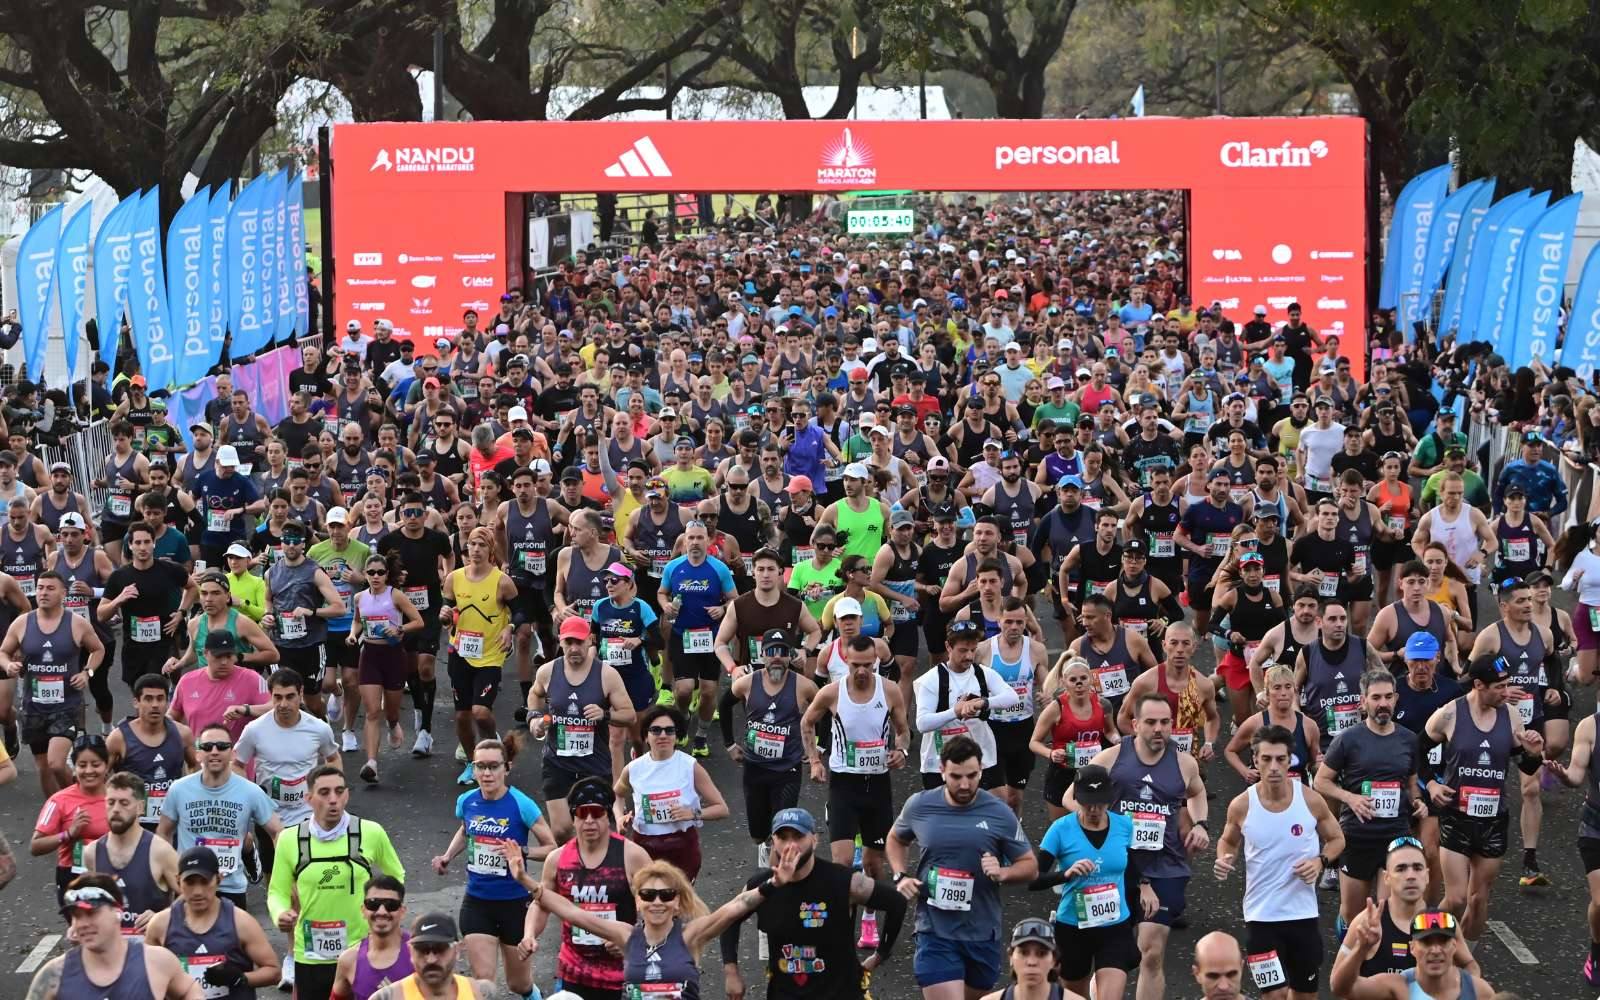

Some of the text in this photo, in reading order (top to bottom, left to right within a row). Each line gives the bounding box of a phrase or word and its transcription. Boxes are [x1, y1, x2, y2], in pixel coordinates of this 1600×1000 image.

[995, 140, 1120, 169] personal
[1220, 140, 1312, 167] Clarín
[817, 168, 876, 178] MARATON
[237, 207, 261, 331] personal
[179, 223, 209, 356] personal
[462, 641, 479, 653] 1927
[693, 638, 710, 648] 6145
[610, 650, 627, 660] 6341
[28, 662, 68, 674] personal
[1105, 679, 1124, 691] 5422
[748, 720, 791, 736] personal
[569, 739, 589, 750] 7164
[858, 755, 880, 768] 8703
[221, 800, 244, 811] TODOS
[1120, 800, 1170, 815] personal
[1375, 798, 1396, 811] 6137
[1473, 803, 1494, 816] 1089
[190, 807, 238, 819] LOS PRESOS
[469, 820, 509, 834] PERKOV
[1136, 830, 1160, 842] 8346
[479, 853, 501, 868] 6232
[941, 887, 967, 901] 7899
[1091, 901, 1116, 917] 8040
[317, 938, 342, 952] 7466
[1255, 970, 1280, 985] 9973
